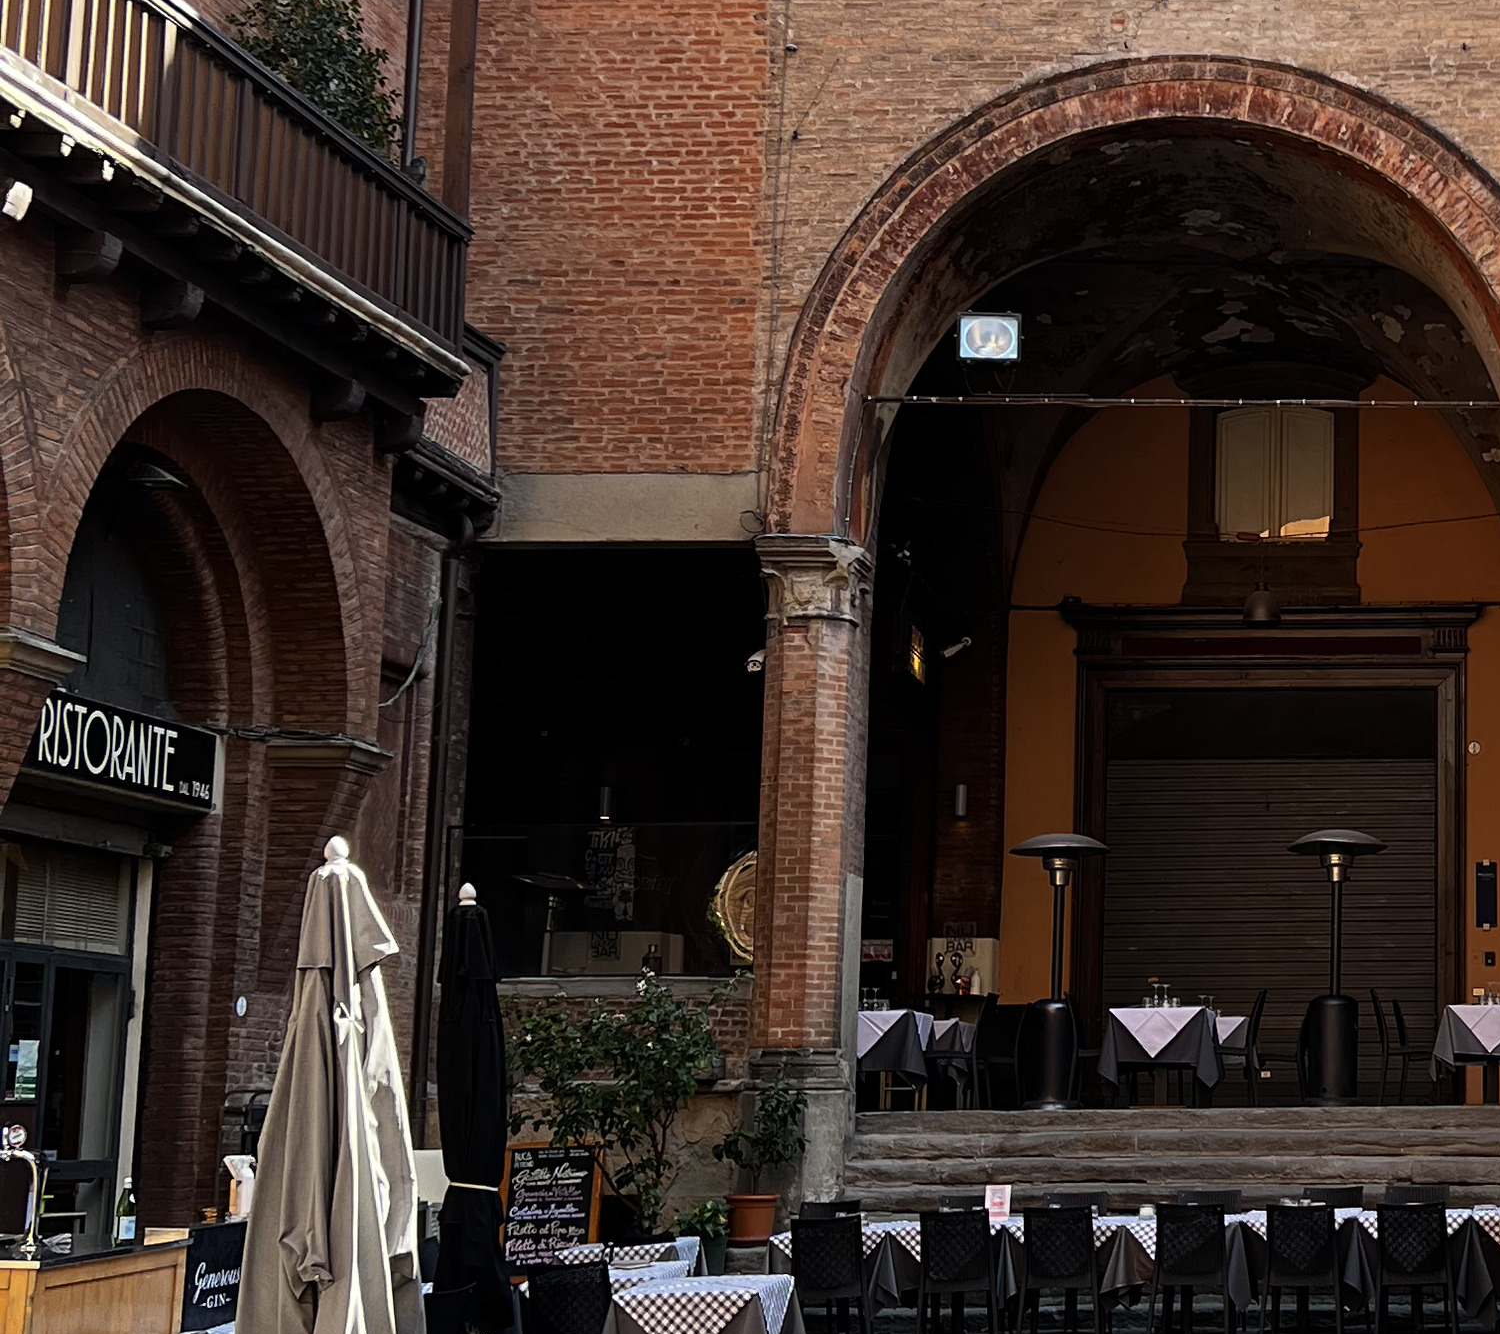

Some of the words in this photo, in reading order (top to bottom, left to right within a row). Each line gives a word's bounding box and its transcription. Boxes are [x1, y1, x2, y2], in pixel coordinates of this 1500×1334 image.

[38, 697, 178, 792] RISTORANTE
[192, 780, 210, 800] 1946
[192, 1261, 241, 1304] Generous
[206, 1292, 228, 1309] GIN
